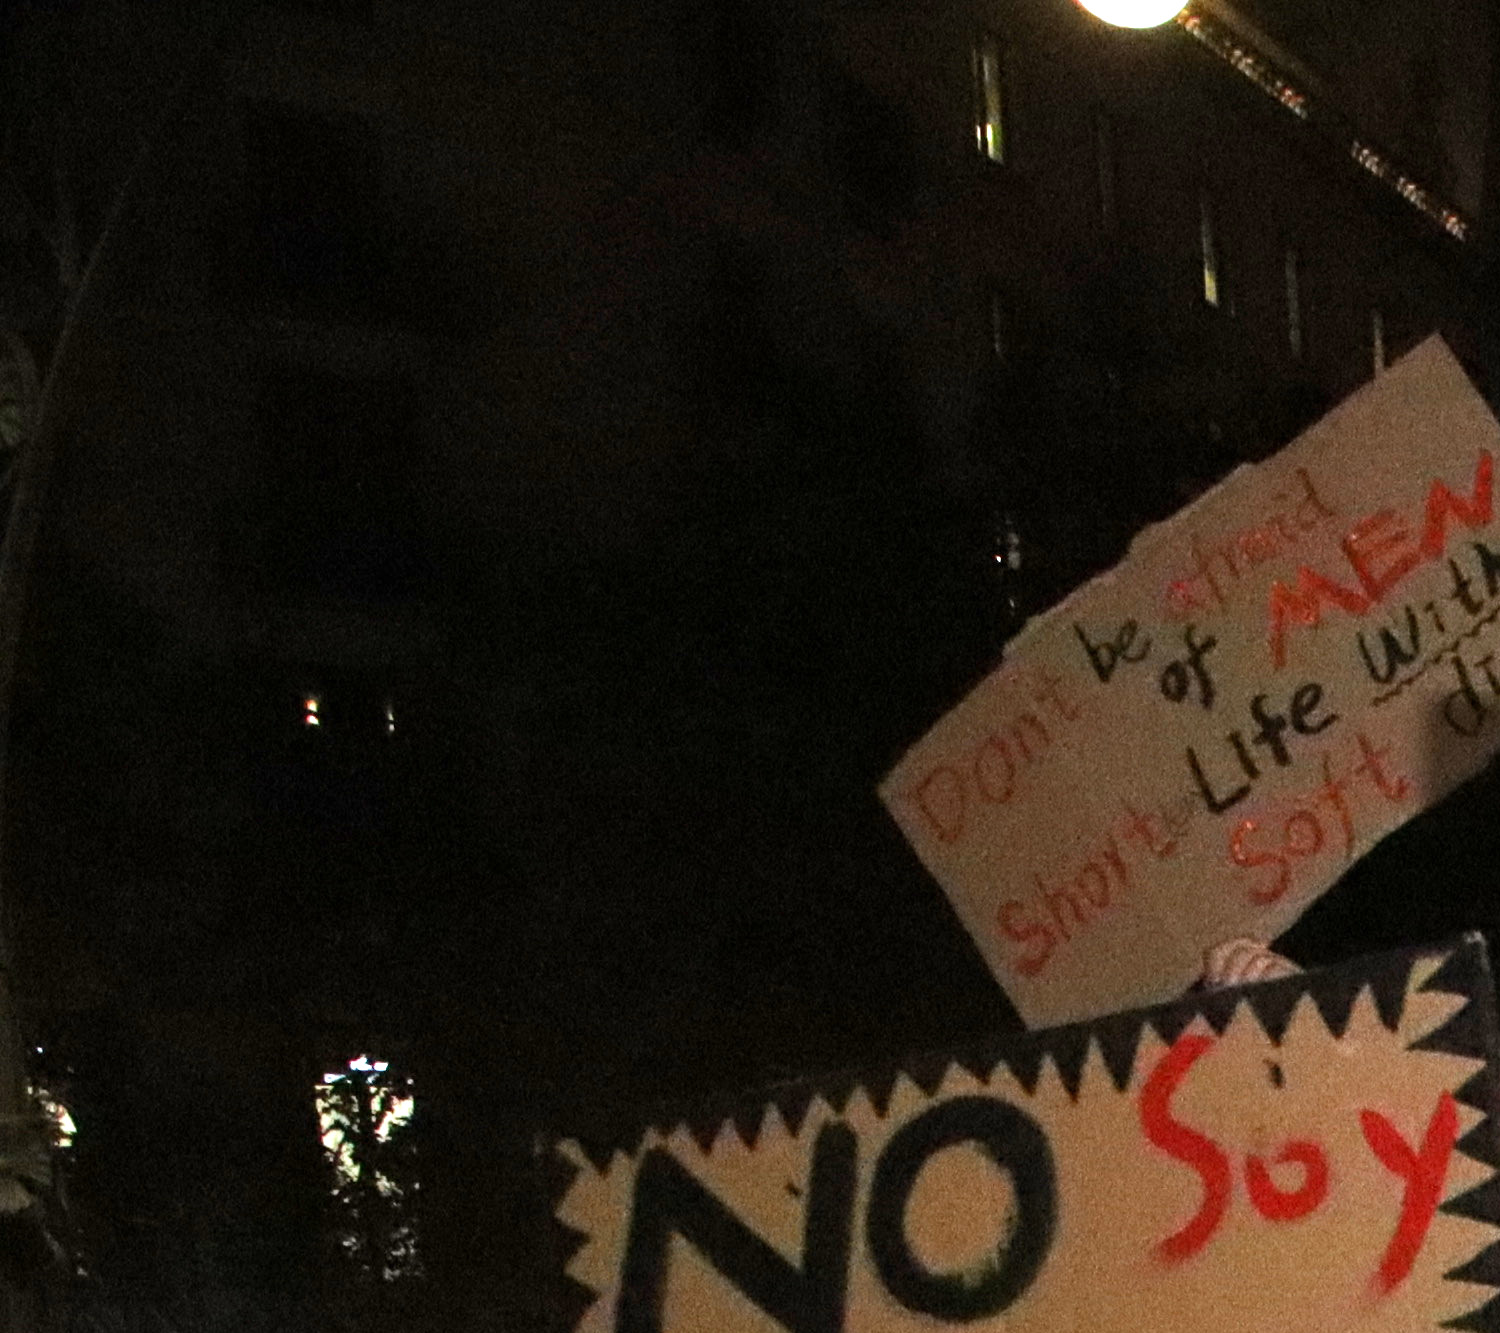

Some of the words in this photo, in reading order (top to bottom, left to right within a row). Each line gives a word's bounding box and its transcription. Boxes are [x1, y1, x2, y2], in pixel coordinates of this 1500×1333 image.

[1074, 619, 1152, 684] be
[1160, 466, 1335, 622] afraid
[1160, 622, 1217, 709] of
[1266, 447, 1495, 670] MEN
[1140, 1035, 1459, 1300] Soy
